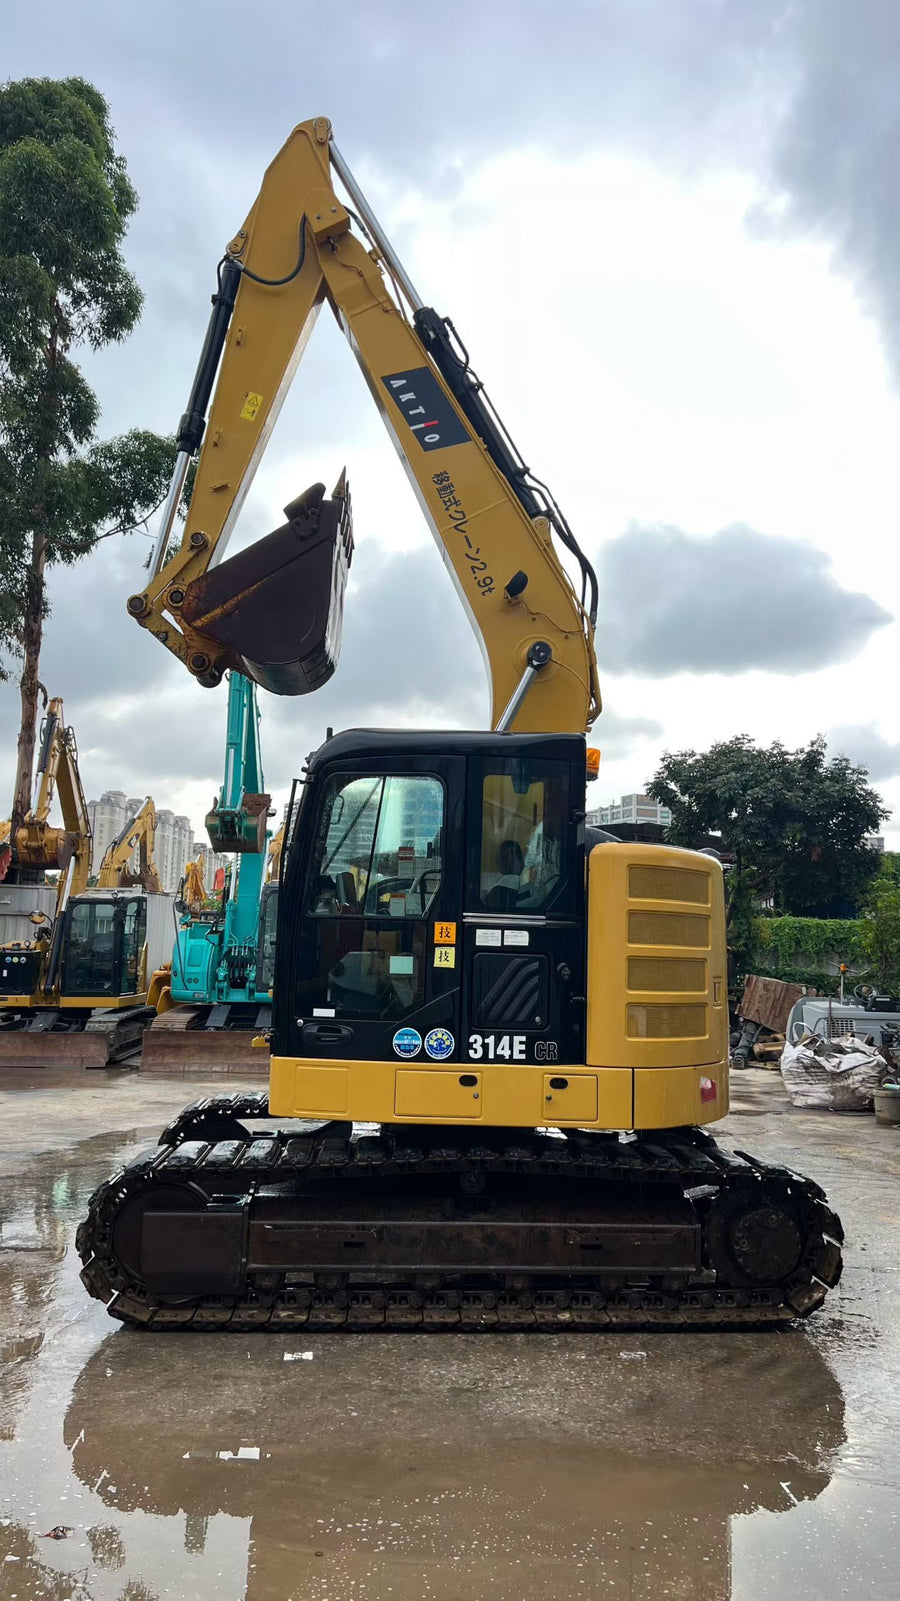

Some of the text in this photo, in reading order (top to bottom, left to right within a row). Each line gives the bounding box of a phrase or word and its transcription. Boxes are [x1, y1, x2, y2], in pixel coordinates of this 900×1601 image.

[390, 379, 440, 443] AKTIO
[431, 469, 495, 597] 移動式クレーン2.9t
[439, 926, 451, 939] 技
[438, 950, 449, 962] 技
[468, 1034, 527, 1060] 314E
[534, 1041, 558, 1061] CR
